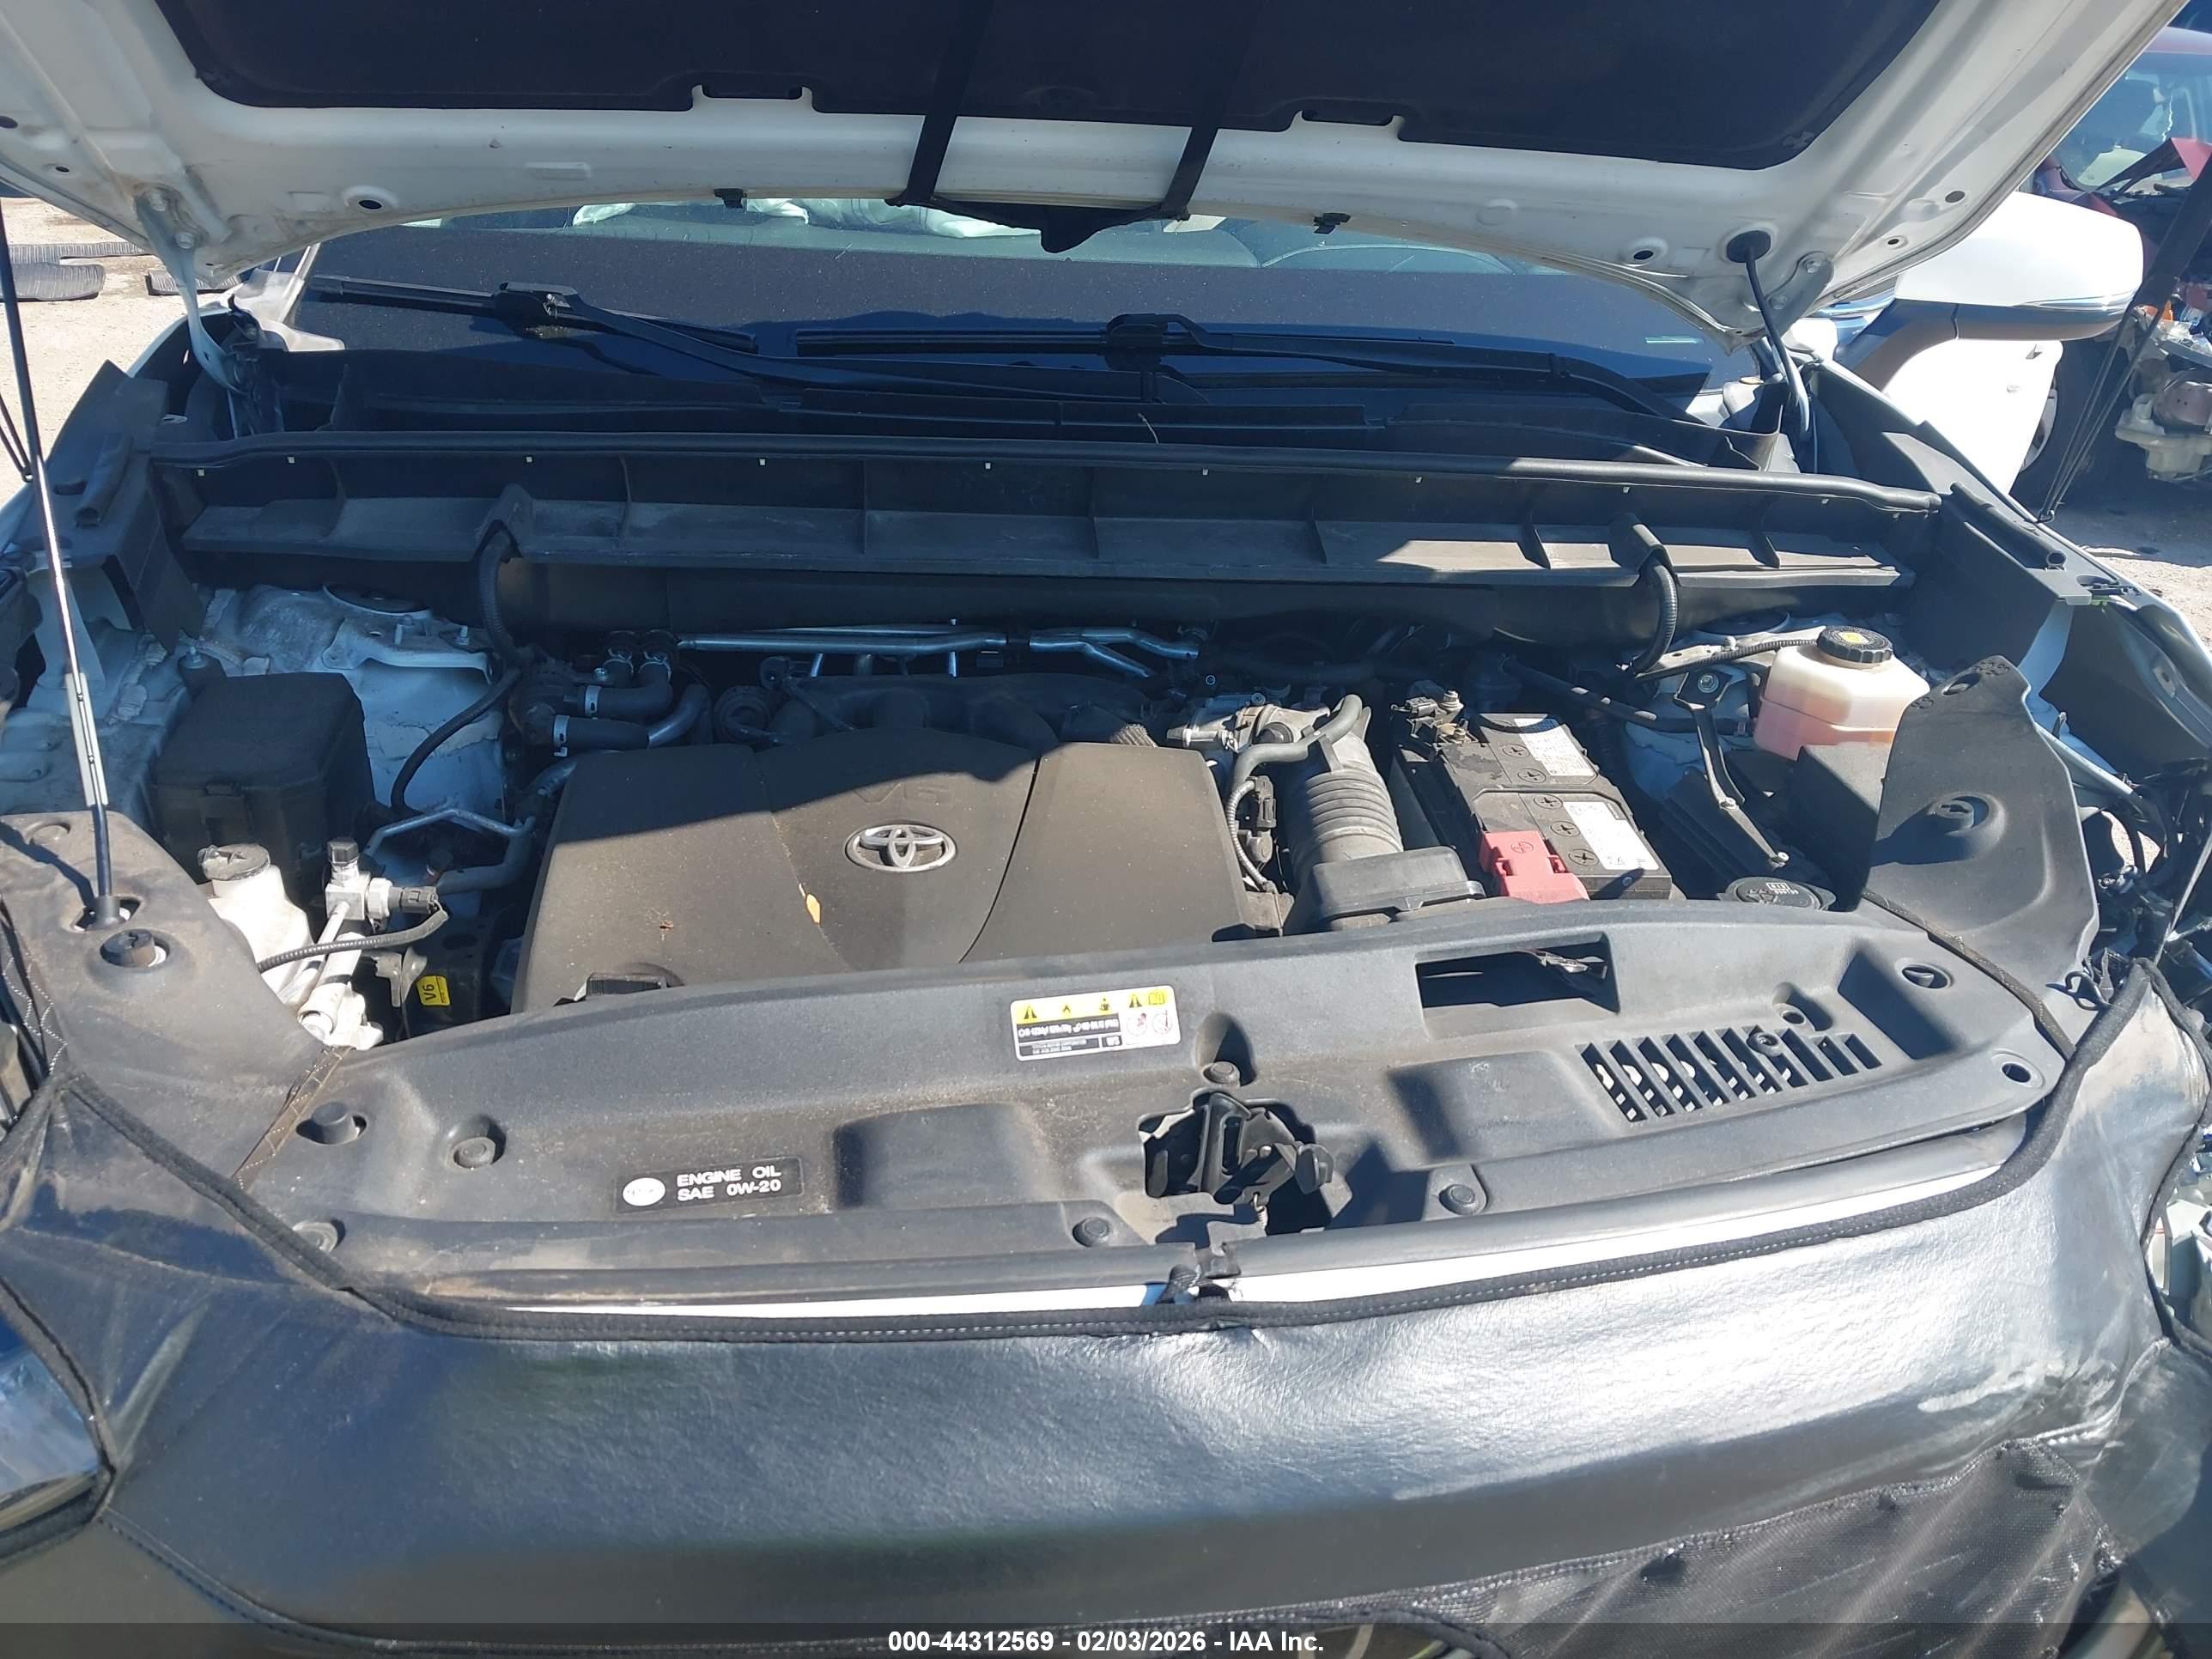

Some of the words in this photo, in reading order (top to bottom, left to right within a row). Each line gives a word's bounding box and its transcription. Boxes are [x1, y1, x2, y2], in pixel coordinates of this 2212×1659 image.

[852, 781, 953, 805] V6
[422, 983, 436, 1001] V6
[677, 1169, 742, 1187] ENGINE
[752, 1165, 782, 1179] OIL
[678, 1186, 714, 1201] SAE
[726, 1179, 781, 1196] 0W-20
